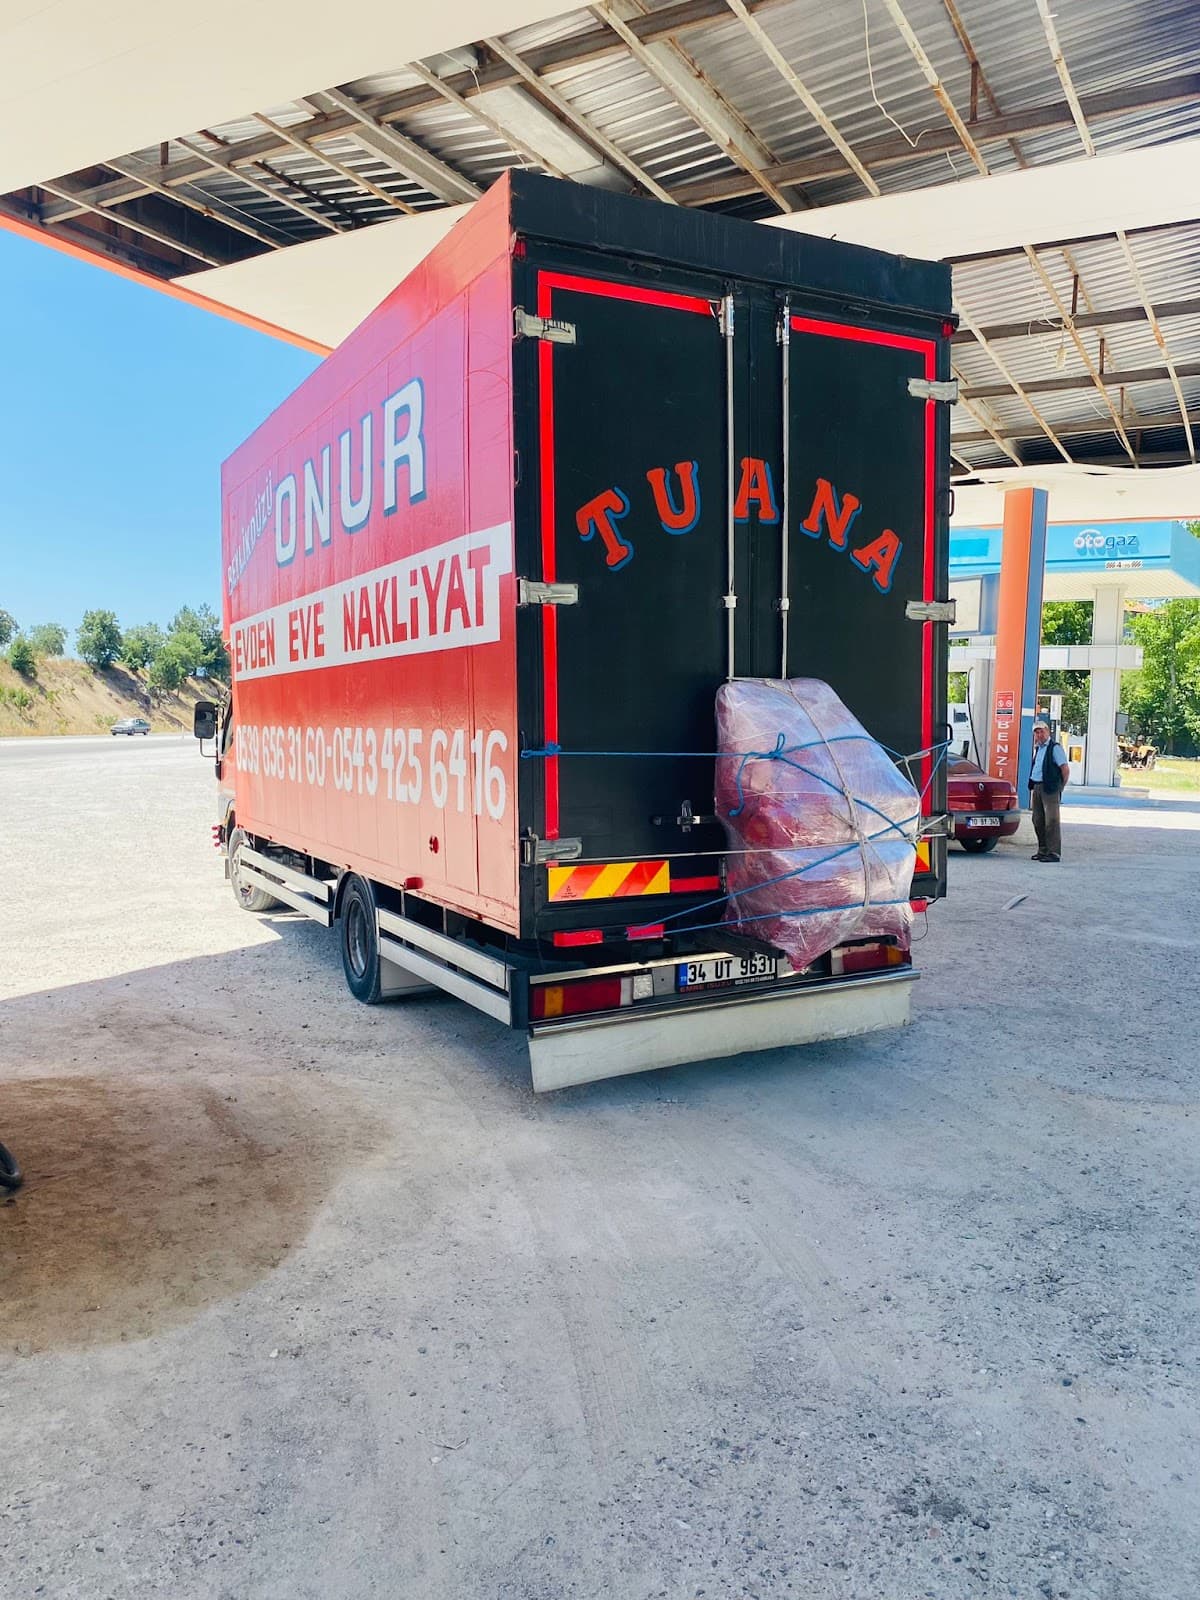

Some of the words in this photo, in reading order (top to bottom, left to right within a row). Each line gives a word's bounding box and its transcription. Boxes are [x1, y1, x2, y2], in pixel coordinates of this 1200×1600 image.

[273, 376, 427, 569] ONUR
[575, 456, 902, 594] TUANA
[235, 617, 277, 673] EVDEN
[288, 602, 325, 663] EVE
[262, 725, 286, 781] 656
[287, 726, 303, 784] 31
[381, 727, 423, 805] 425
[688, 964, 706, 983] 34
[715, 960, 733, 979] UT
[740, 956, 774, 976] 9631
